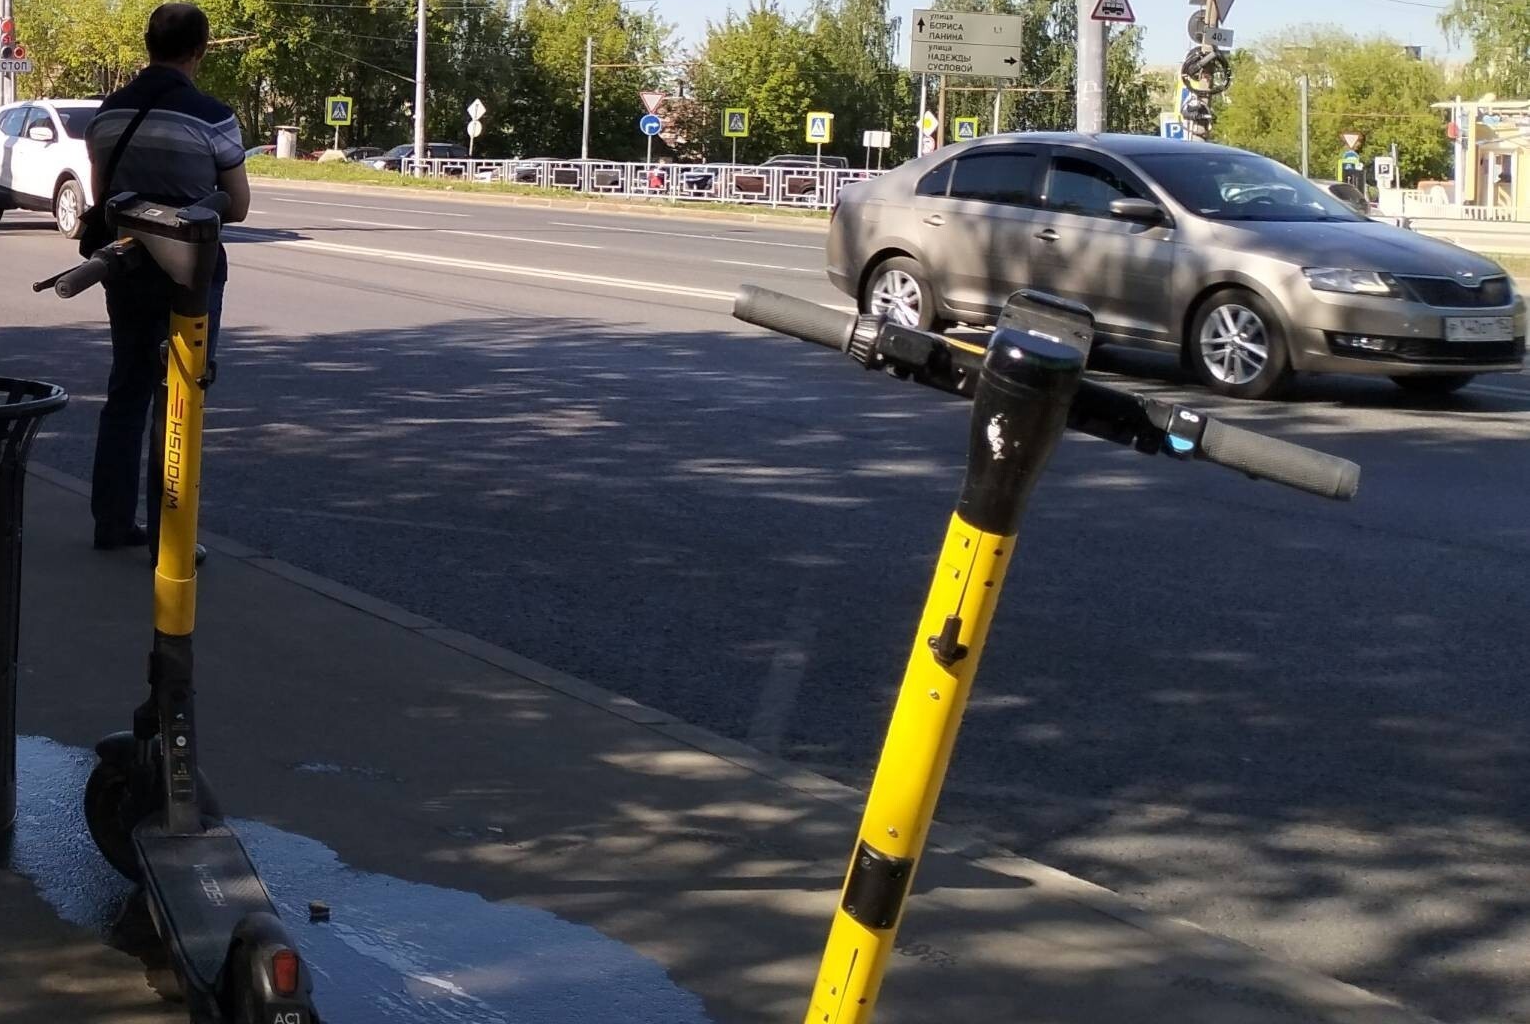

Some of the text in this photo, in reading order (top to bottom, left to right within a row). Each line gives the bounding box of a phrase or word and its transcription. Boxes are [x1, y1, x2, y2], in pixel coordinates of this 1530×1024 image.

[929, 22, 964, 31] БОРИСА
[928, 32, 964, 41] ПАНИНА
[1211, 32, 1223, 42] 40
[927, 53, 972, 63] НАДЕЖДЫ
[1, 62, 27, 70] СТОП
[927, 63, 973, 73] СУСЛОВОЙ
[165, 420, 183, 511] WHOOSH
